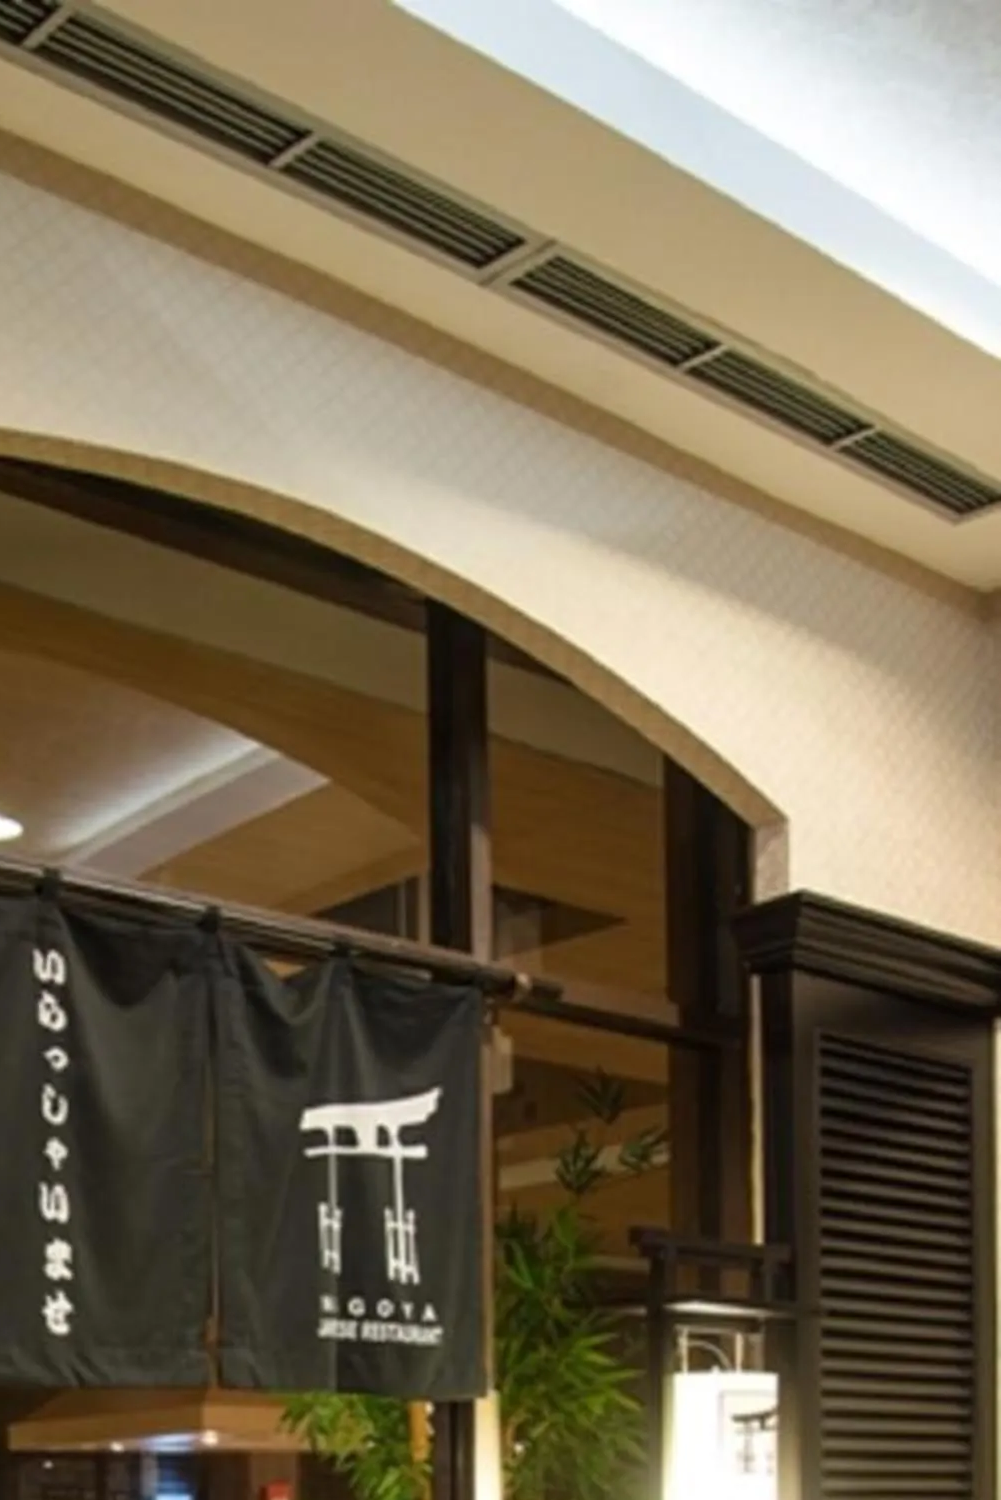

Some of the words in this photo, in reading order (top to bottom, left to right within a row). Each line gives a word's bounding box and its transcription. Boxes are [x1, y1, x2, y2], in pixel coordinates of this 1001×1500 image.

[32, 948, 74, 1337] いらっしゃいませ
